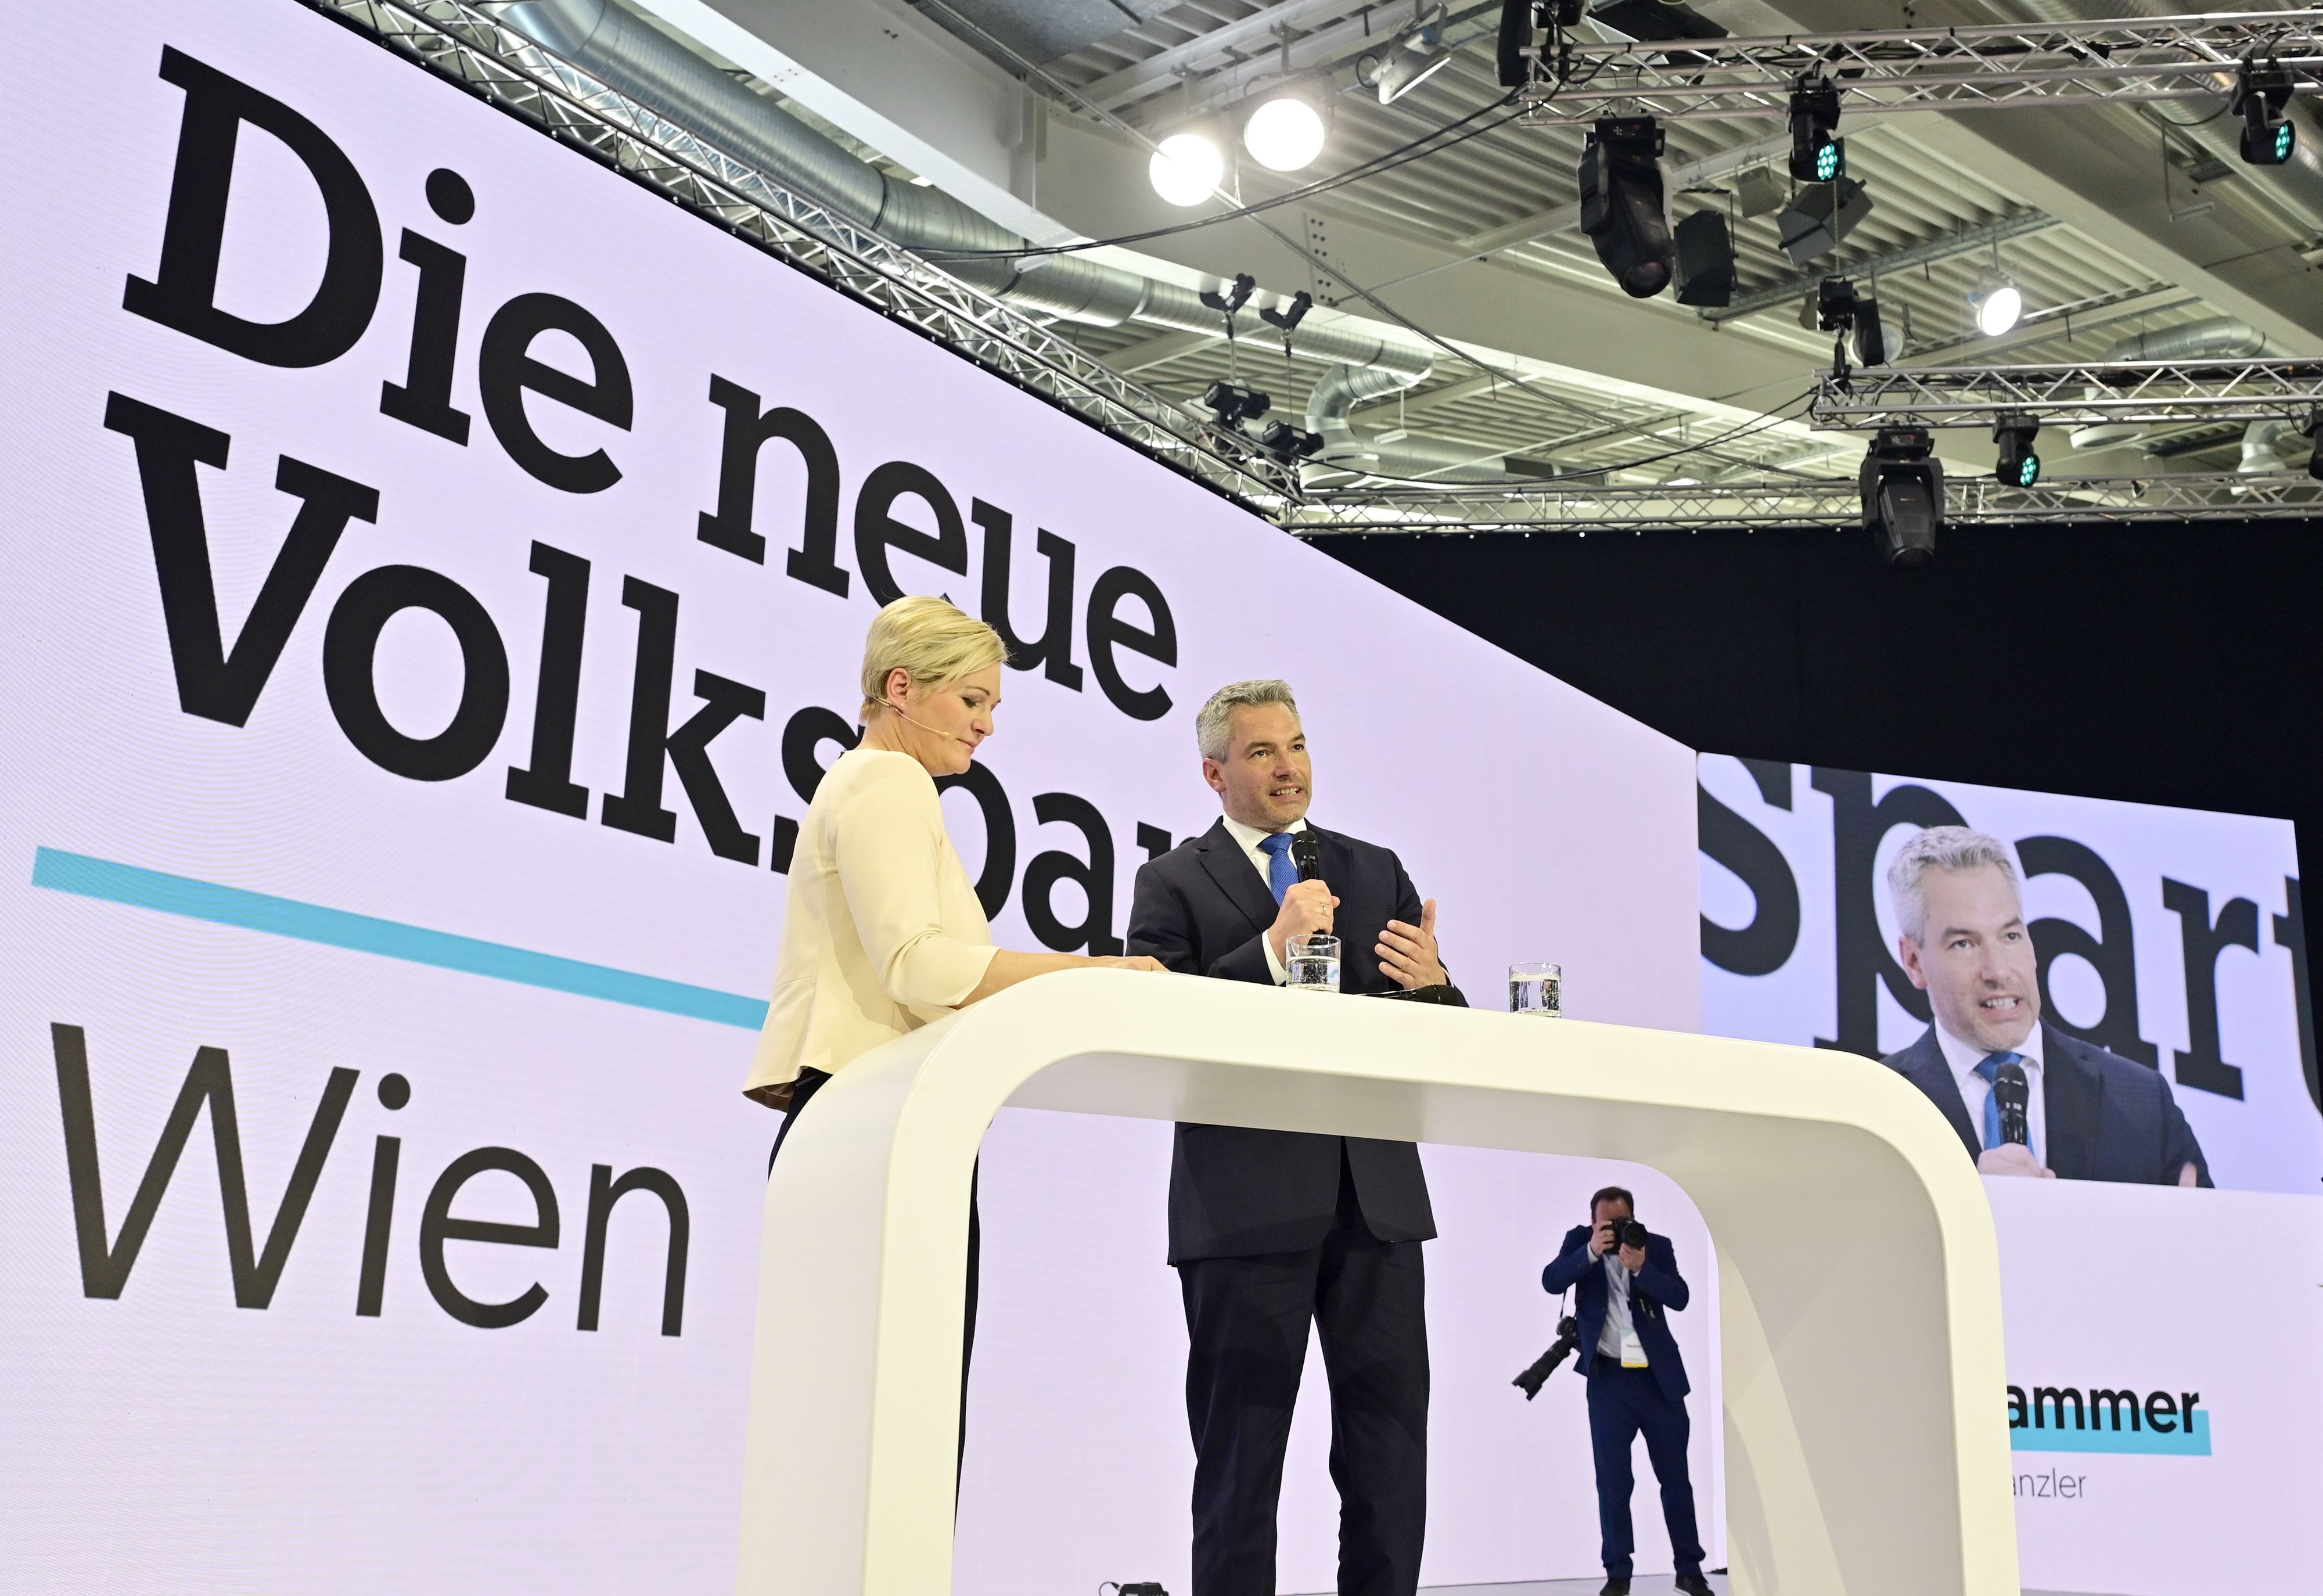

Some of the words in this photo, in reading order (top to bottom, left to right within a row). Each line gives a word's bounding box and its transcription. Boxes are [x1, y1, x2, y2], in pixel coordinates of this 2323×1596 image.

[123, 44, 633, 494] Die
[698, 373, 1178, 721] neue
[103, 390, 1199, 957] Volka
[51, 1022, 689, 1337] Wien
[2012, 1468, 2087, 1498] nzler
